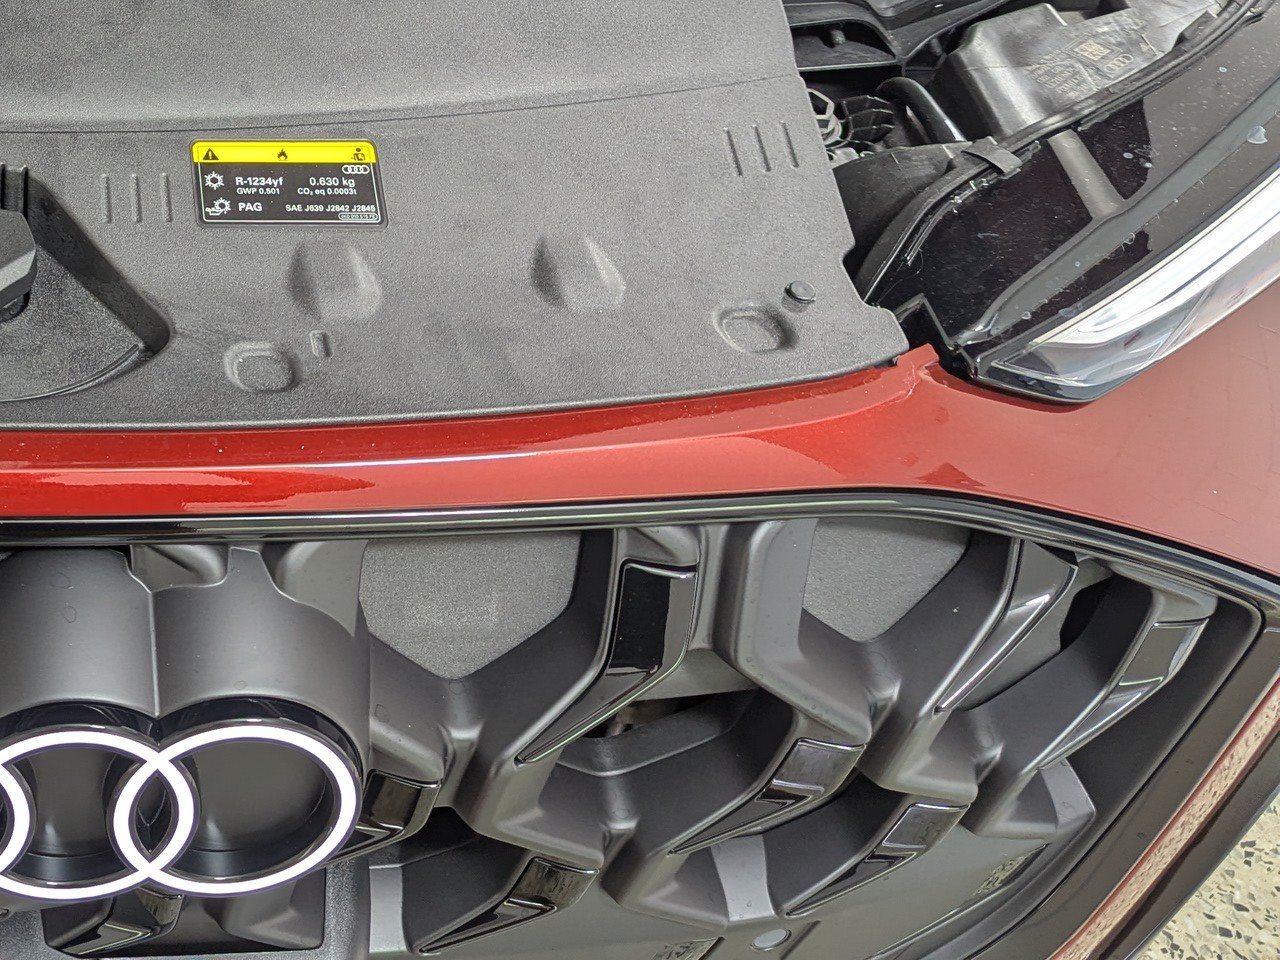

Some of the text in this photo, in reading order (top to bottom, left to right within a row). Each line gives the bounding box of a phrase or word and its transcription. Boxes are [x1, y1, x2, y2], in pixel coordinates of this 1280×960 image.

[236, 177, 355, 187] R-1234yf 0.630 kg
[238, 203, 262, 211] PAG
